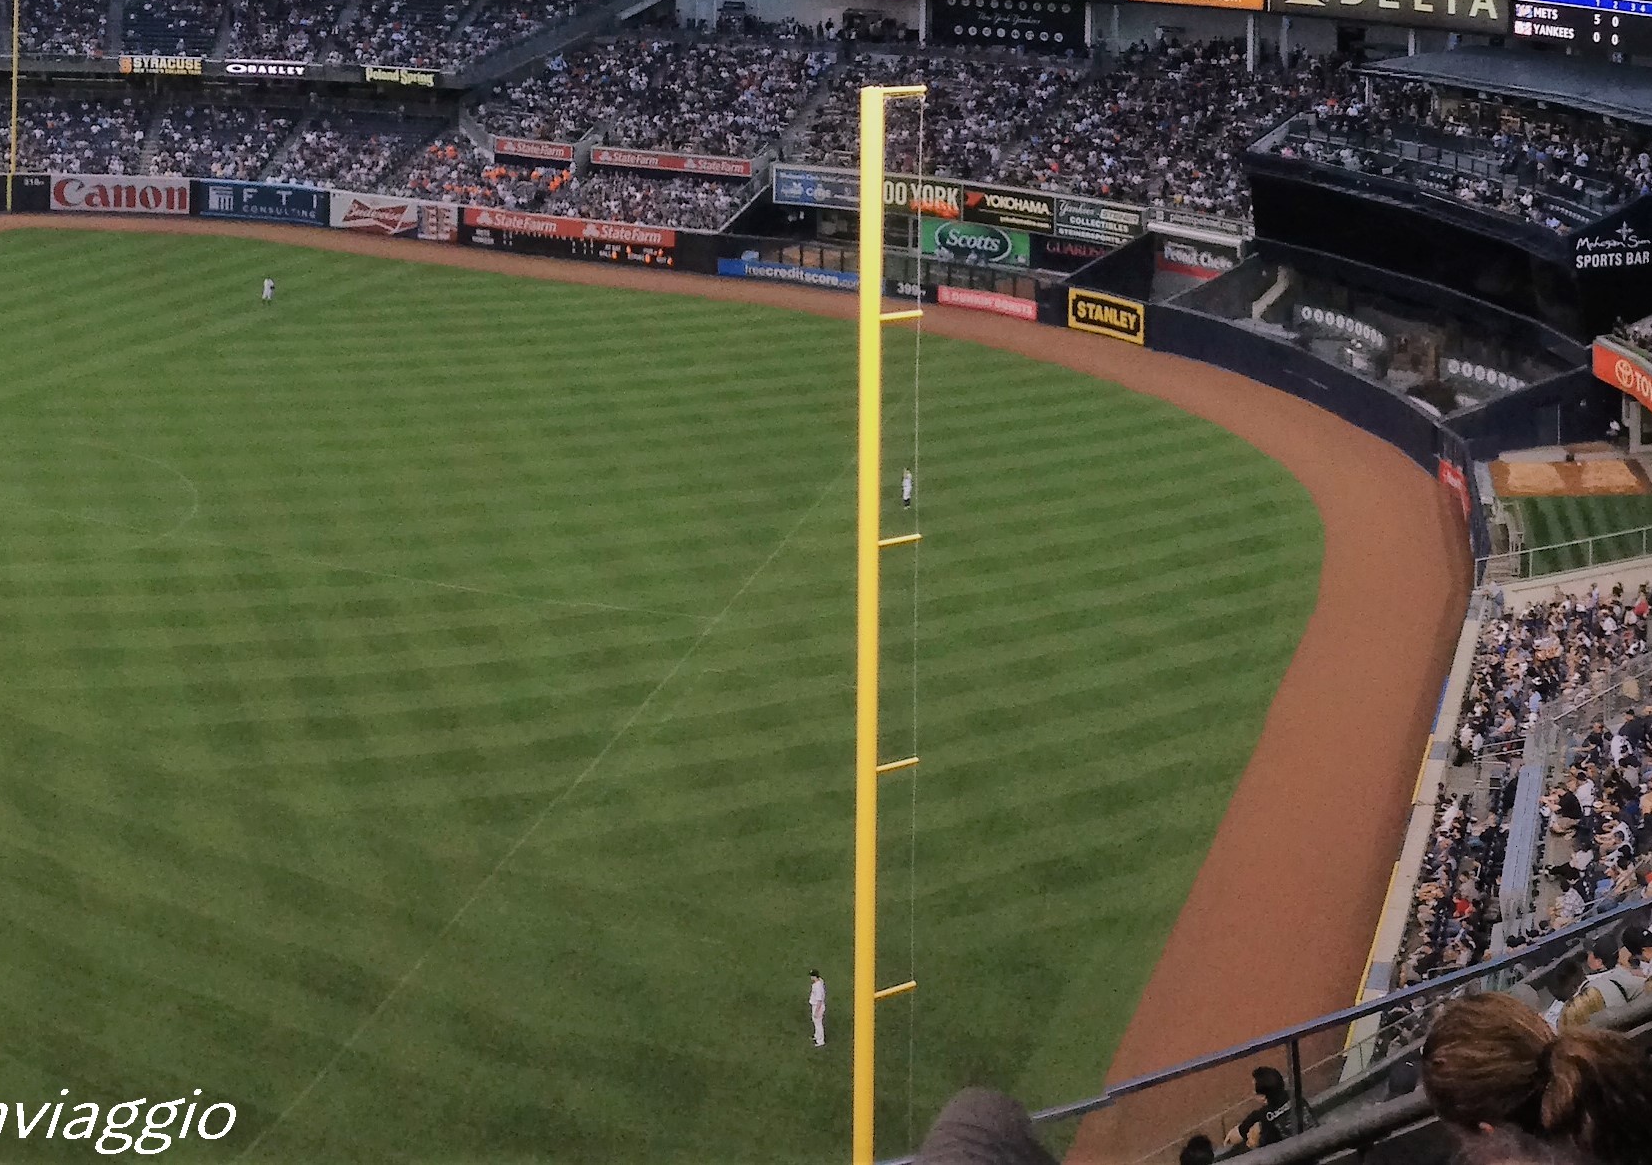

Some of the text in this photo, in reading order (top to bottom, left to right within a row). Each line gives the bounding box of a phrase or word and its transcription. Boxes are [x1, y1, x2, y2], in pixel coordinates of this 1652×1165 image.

[1533, 6, 1558, 21] METS
[1612, 15, 1619, 28] 0
[1533, 22, 1575, 40] YANKEES
[1594, 31, 1600, 43] 0
[1612, 33, 1619, 46] 0
[133, 57, 202, 70] SYRACUSE
[365, 66, 434, 87] Poland Spring
[53, 177, 188, 210] Canon
[911, 184, 960, 211] YORK
[984, 193, 1052, 215] YOKOHAMA
[1070, 215, 1129, 233] COLLECTIBLES
[945, 229, 1001, 252] Scotts
[1576, 250, 1650, 269] SPORTS BAR
[744, 263, 861, 290] freecreditscore.co
[1077, 300, 1137, 331] STANLEY
